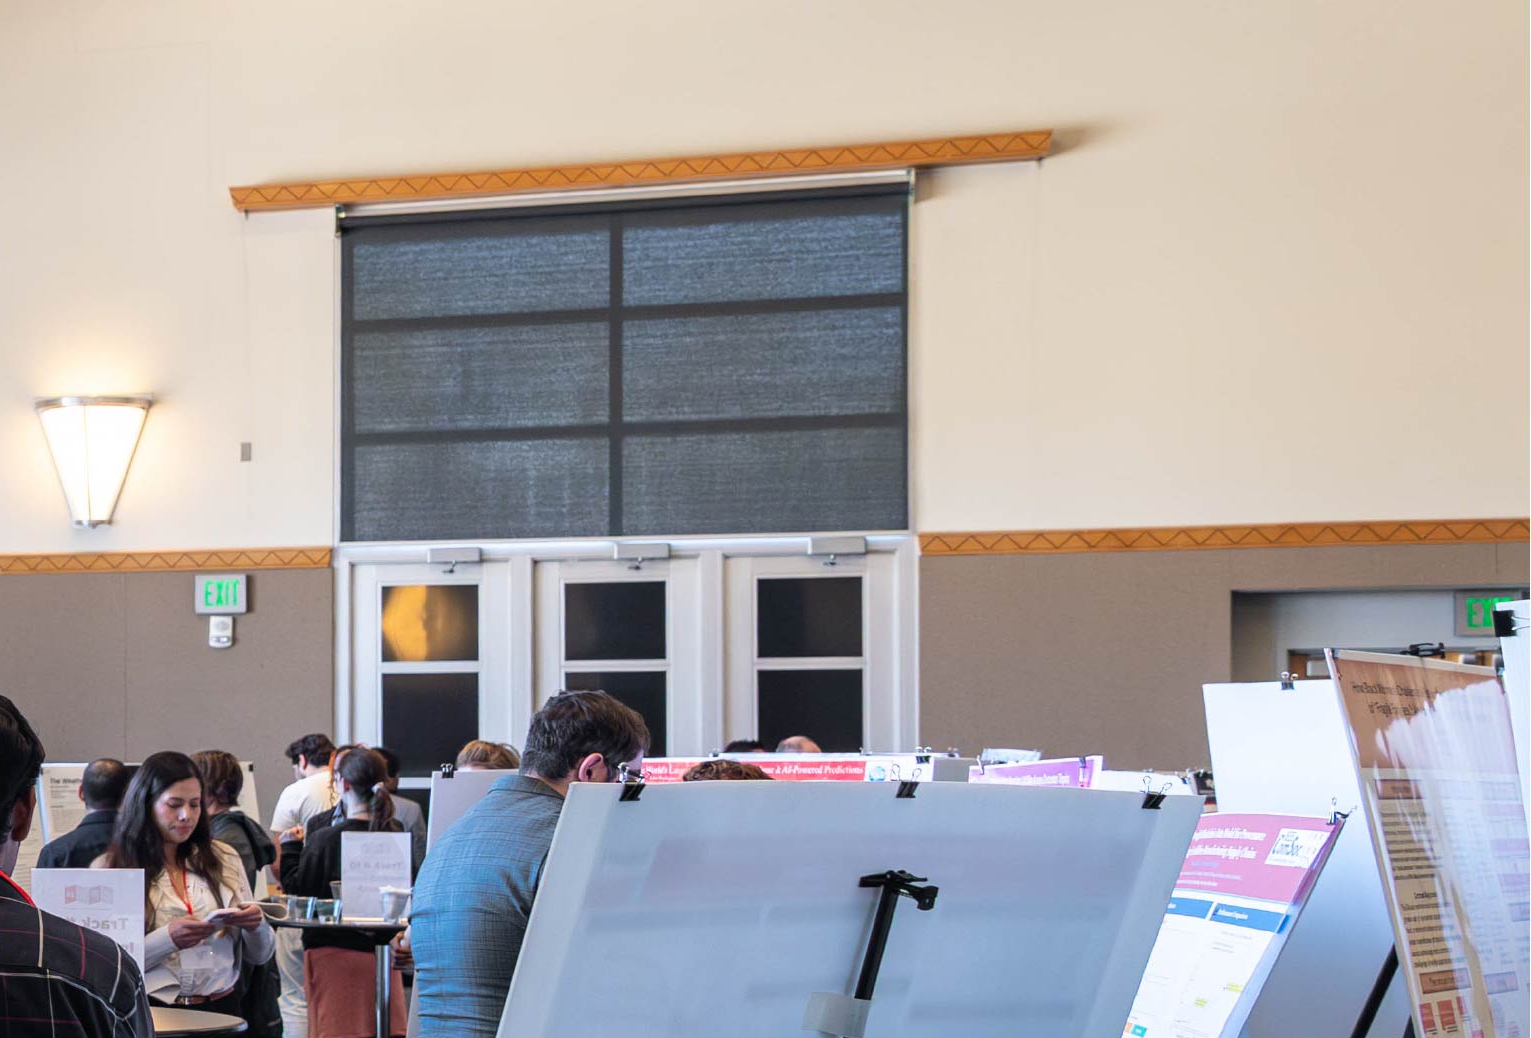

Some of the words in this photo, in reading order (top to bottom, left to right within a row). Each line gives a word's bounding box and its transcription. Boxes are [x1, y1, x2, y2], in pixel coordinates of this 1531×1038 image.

[204, 580, 240, 607] EXIT
[1466, 597, 1514, 628] EX
[824, 764, 864, 775] Predictions
